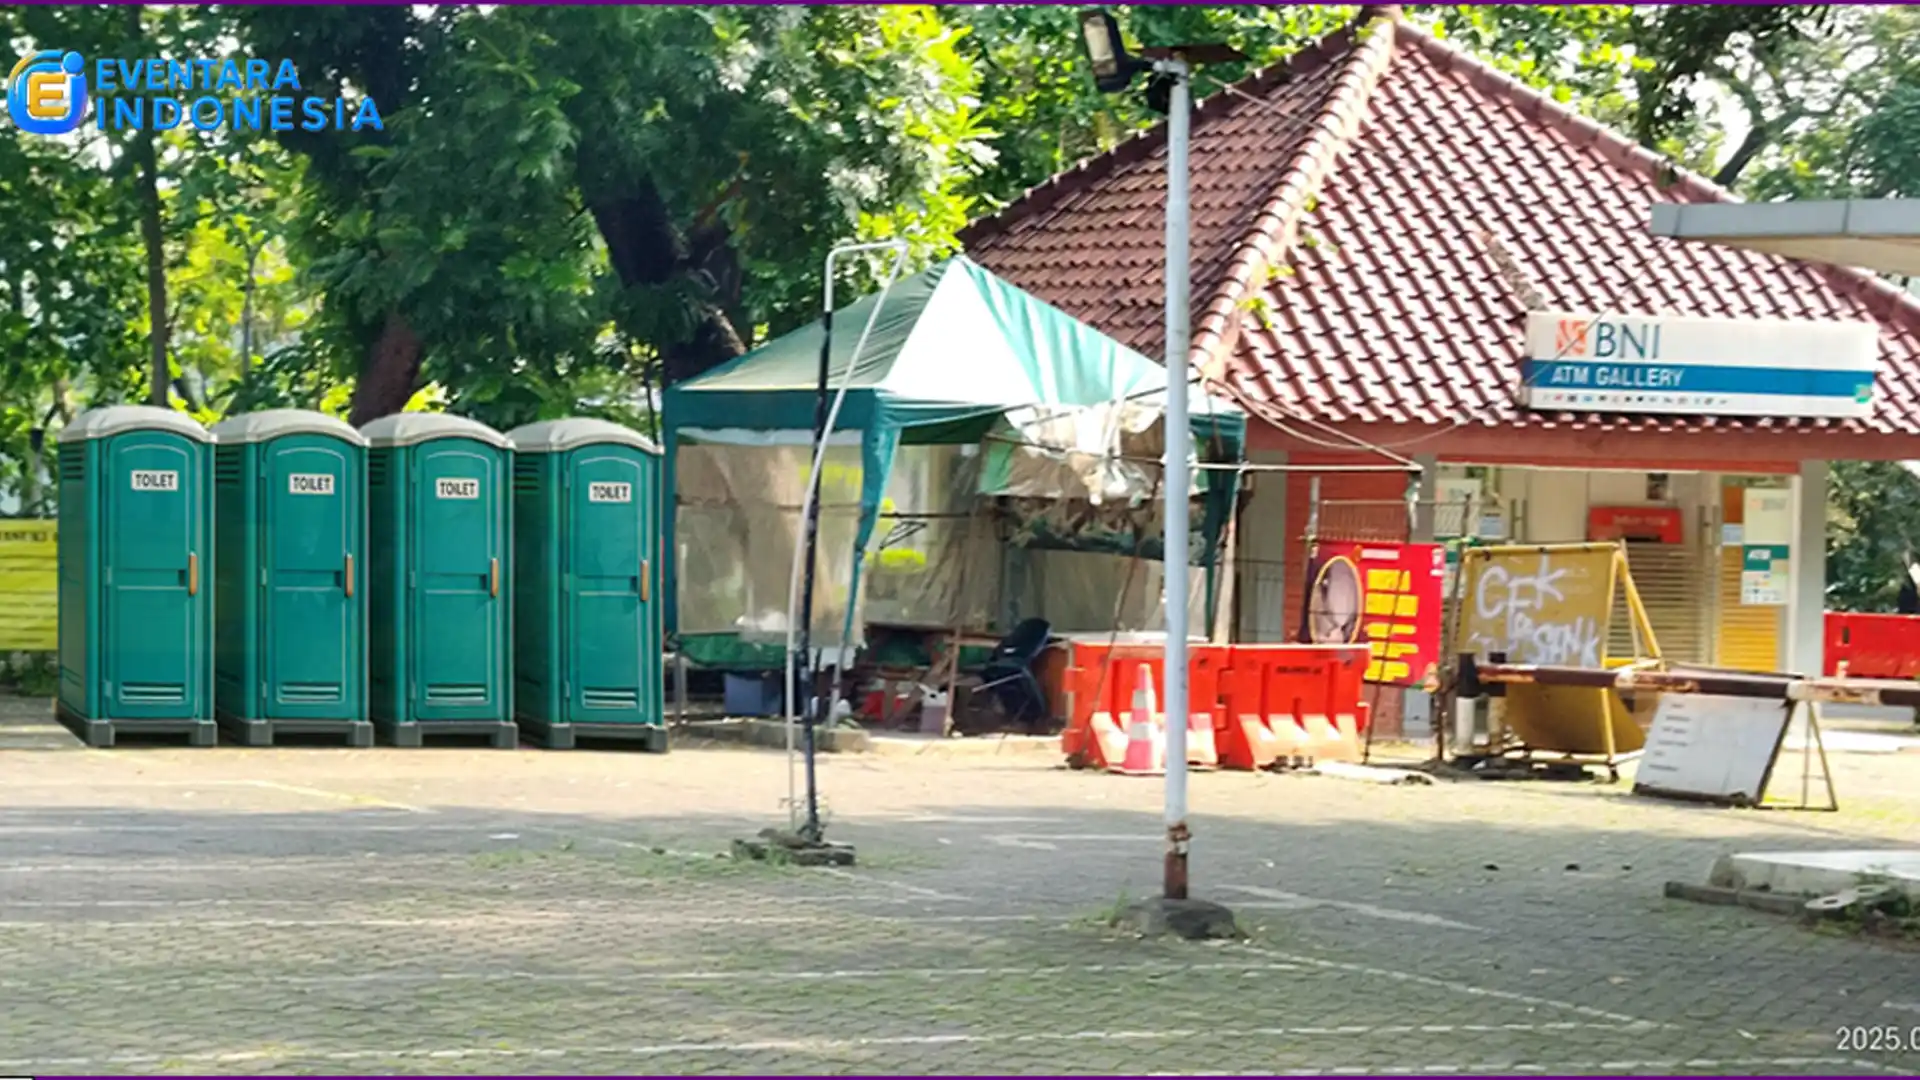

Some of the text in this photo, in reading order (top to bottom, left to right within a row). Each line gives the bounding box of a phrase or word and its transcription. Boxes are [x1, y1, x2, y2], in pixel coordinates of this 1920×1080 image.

[1594, 322, 1660, 360] BNI
[1550, 365, 1686, 387] ATM GALLERY
[134, 473, 175, 488] TOILET
[291, 475, 331, 491] TOILET
[439, 481, 476, 496] TOILET
[591, 485, 629, 500] TOILET
